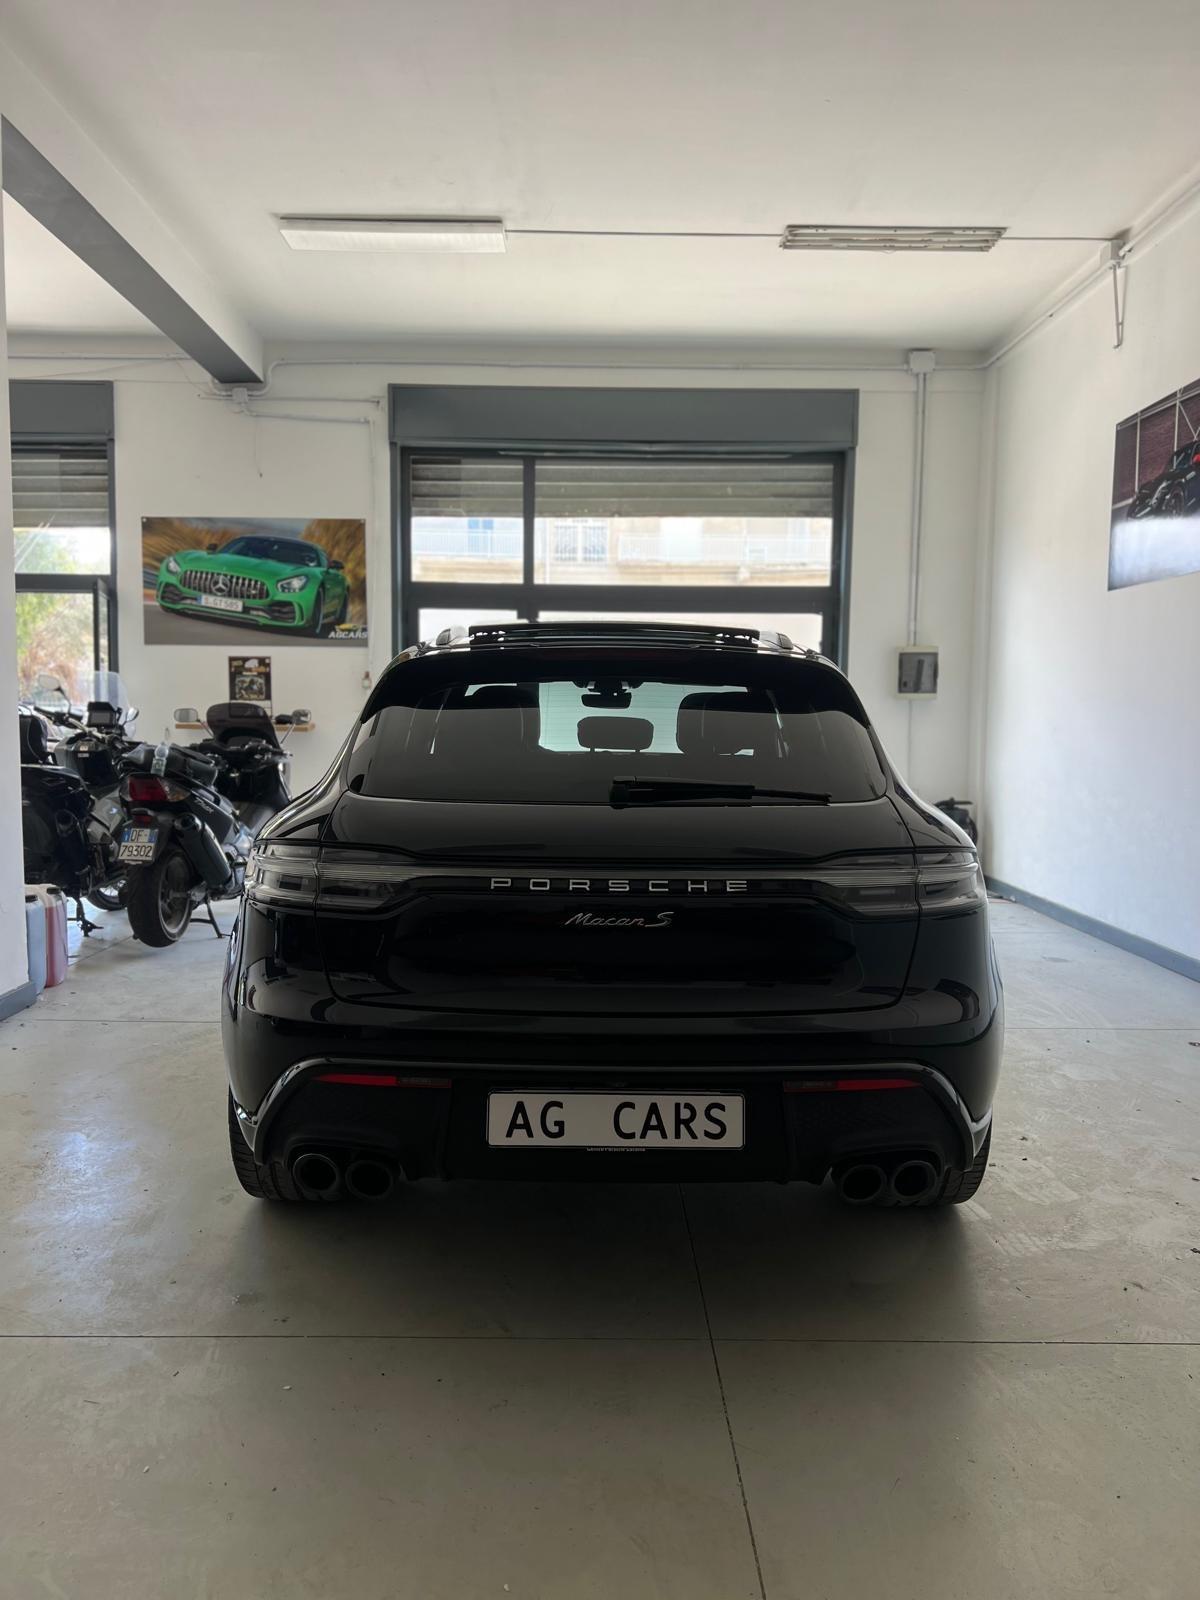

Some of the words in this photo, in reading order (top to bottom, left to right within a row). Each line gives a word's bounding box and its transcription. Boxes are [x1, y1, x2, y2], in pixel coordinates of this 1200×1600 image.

[120, 844, 153, 857] 79302
[490, 878, 748, 893] PORSCHE
[564, 912, 645, 926] Macan
[645, 911, 675, 927] S
[505, 1100, 566, 1139] AG
[613, 1101, 728, 1140] CARS
